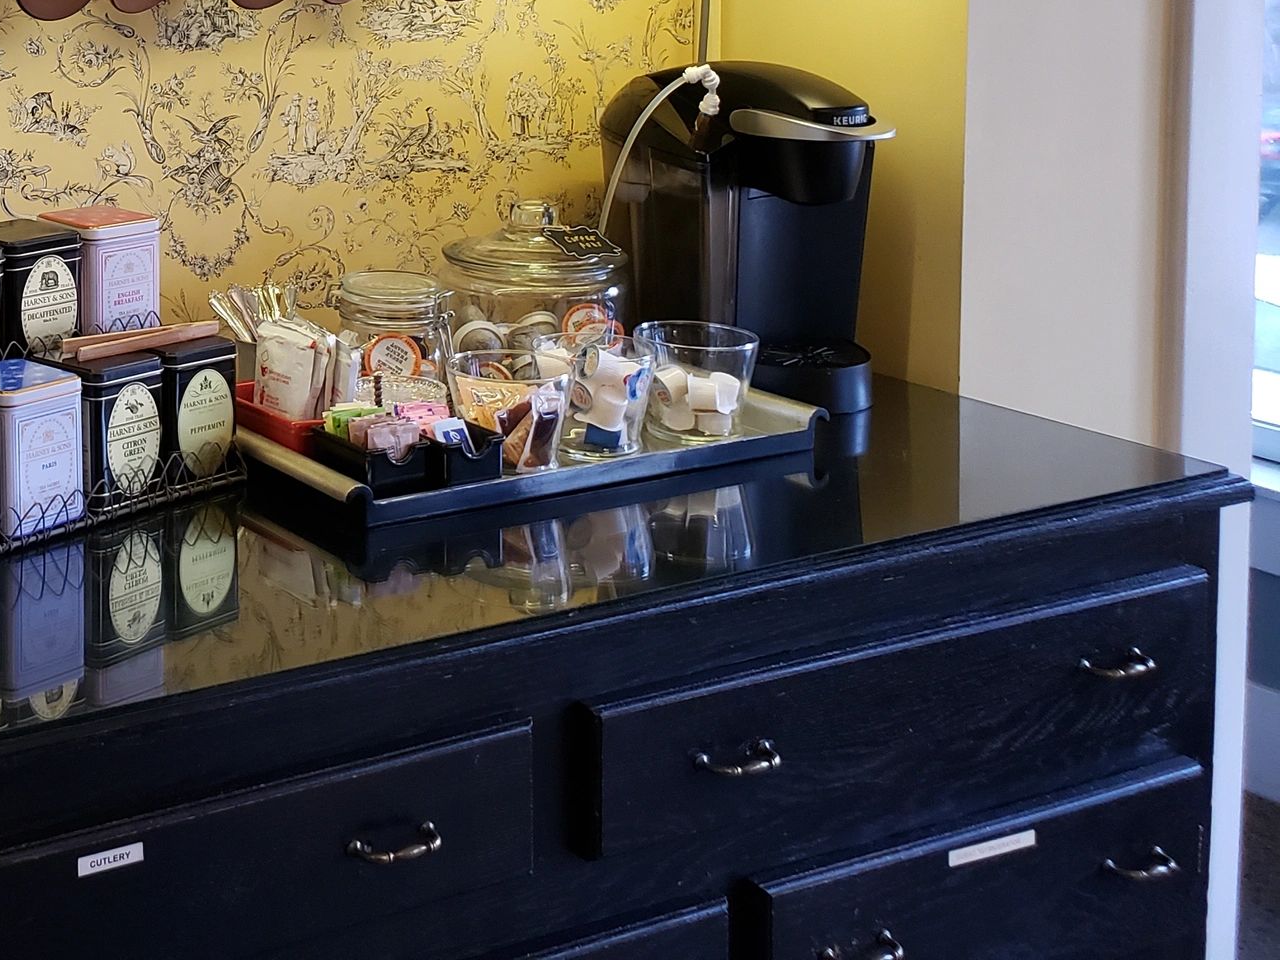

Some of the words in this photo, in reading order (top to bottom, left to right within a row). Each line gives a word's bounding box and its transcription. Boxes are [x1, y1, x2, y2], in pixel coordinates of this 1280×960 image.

[833, 114, 868, 125] KEURIG
[23, 295, 52, 308] HARNEY
[52, 294, 58, 302] &
[59, 291, 75, 300] SONS
[117, 289, 141, 299] ENGLISH
[113, 295, 144, 306] BREAKFAST
[27, 306, 73, 321] DECAFFEINATED
[183, 399, 207, 408] HARNEY
[109, 425, 136, 438] HARNEY
[143, 419, 158, 430] SONS
[190, 420, 225, 435] PEPPERMINT
[122, 437, 147, 450] CITRON
[124, 446, 146, 457] GREEN
[41, 461, 57, 470] PARIS
[89, 851, 131, 868] CUTLERY
